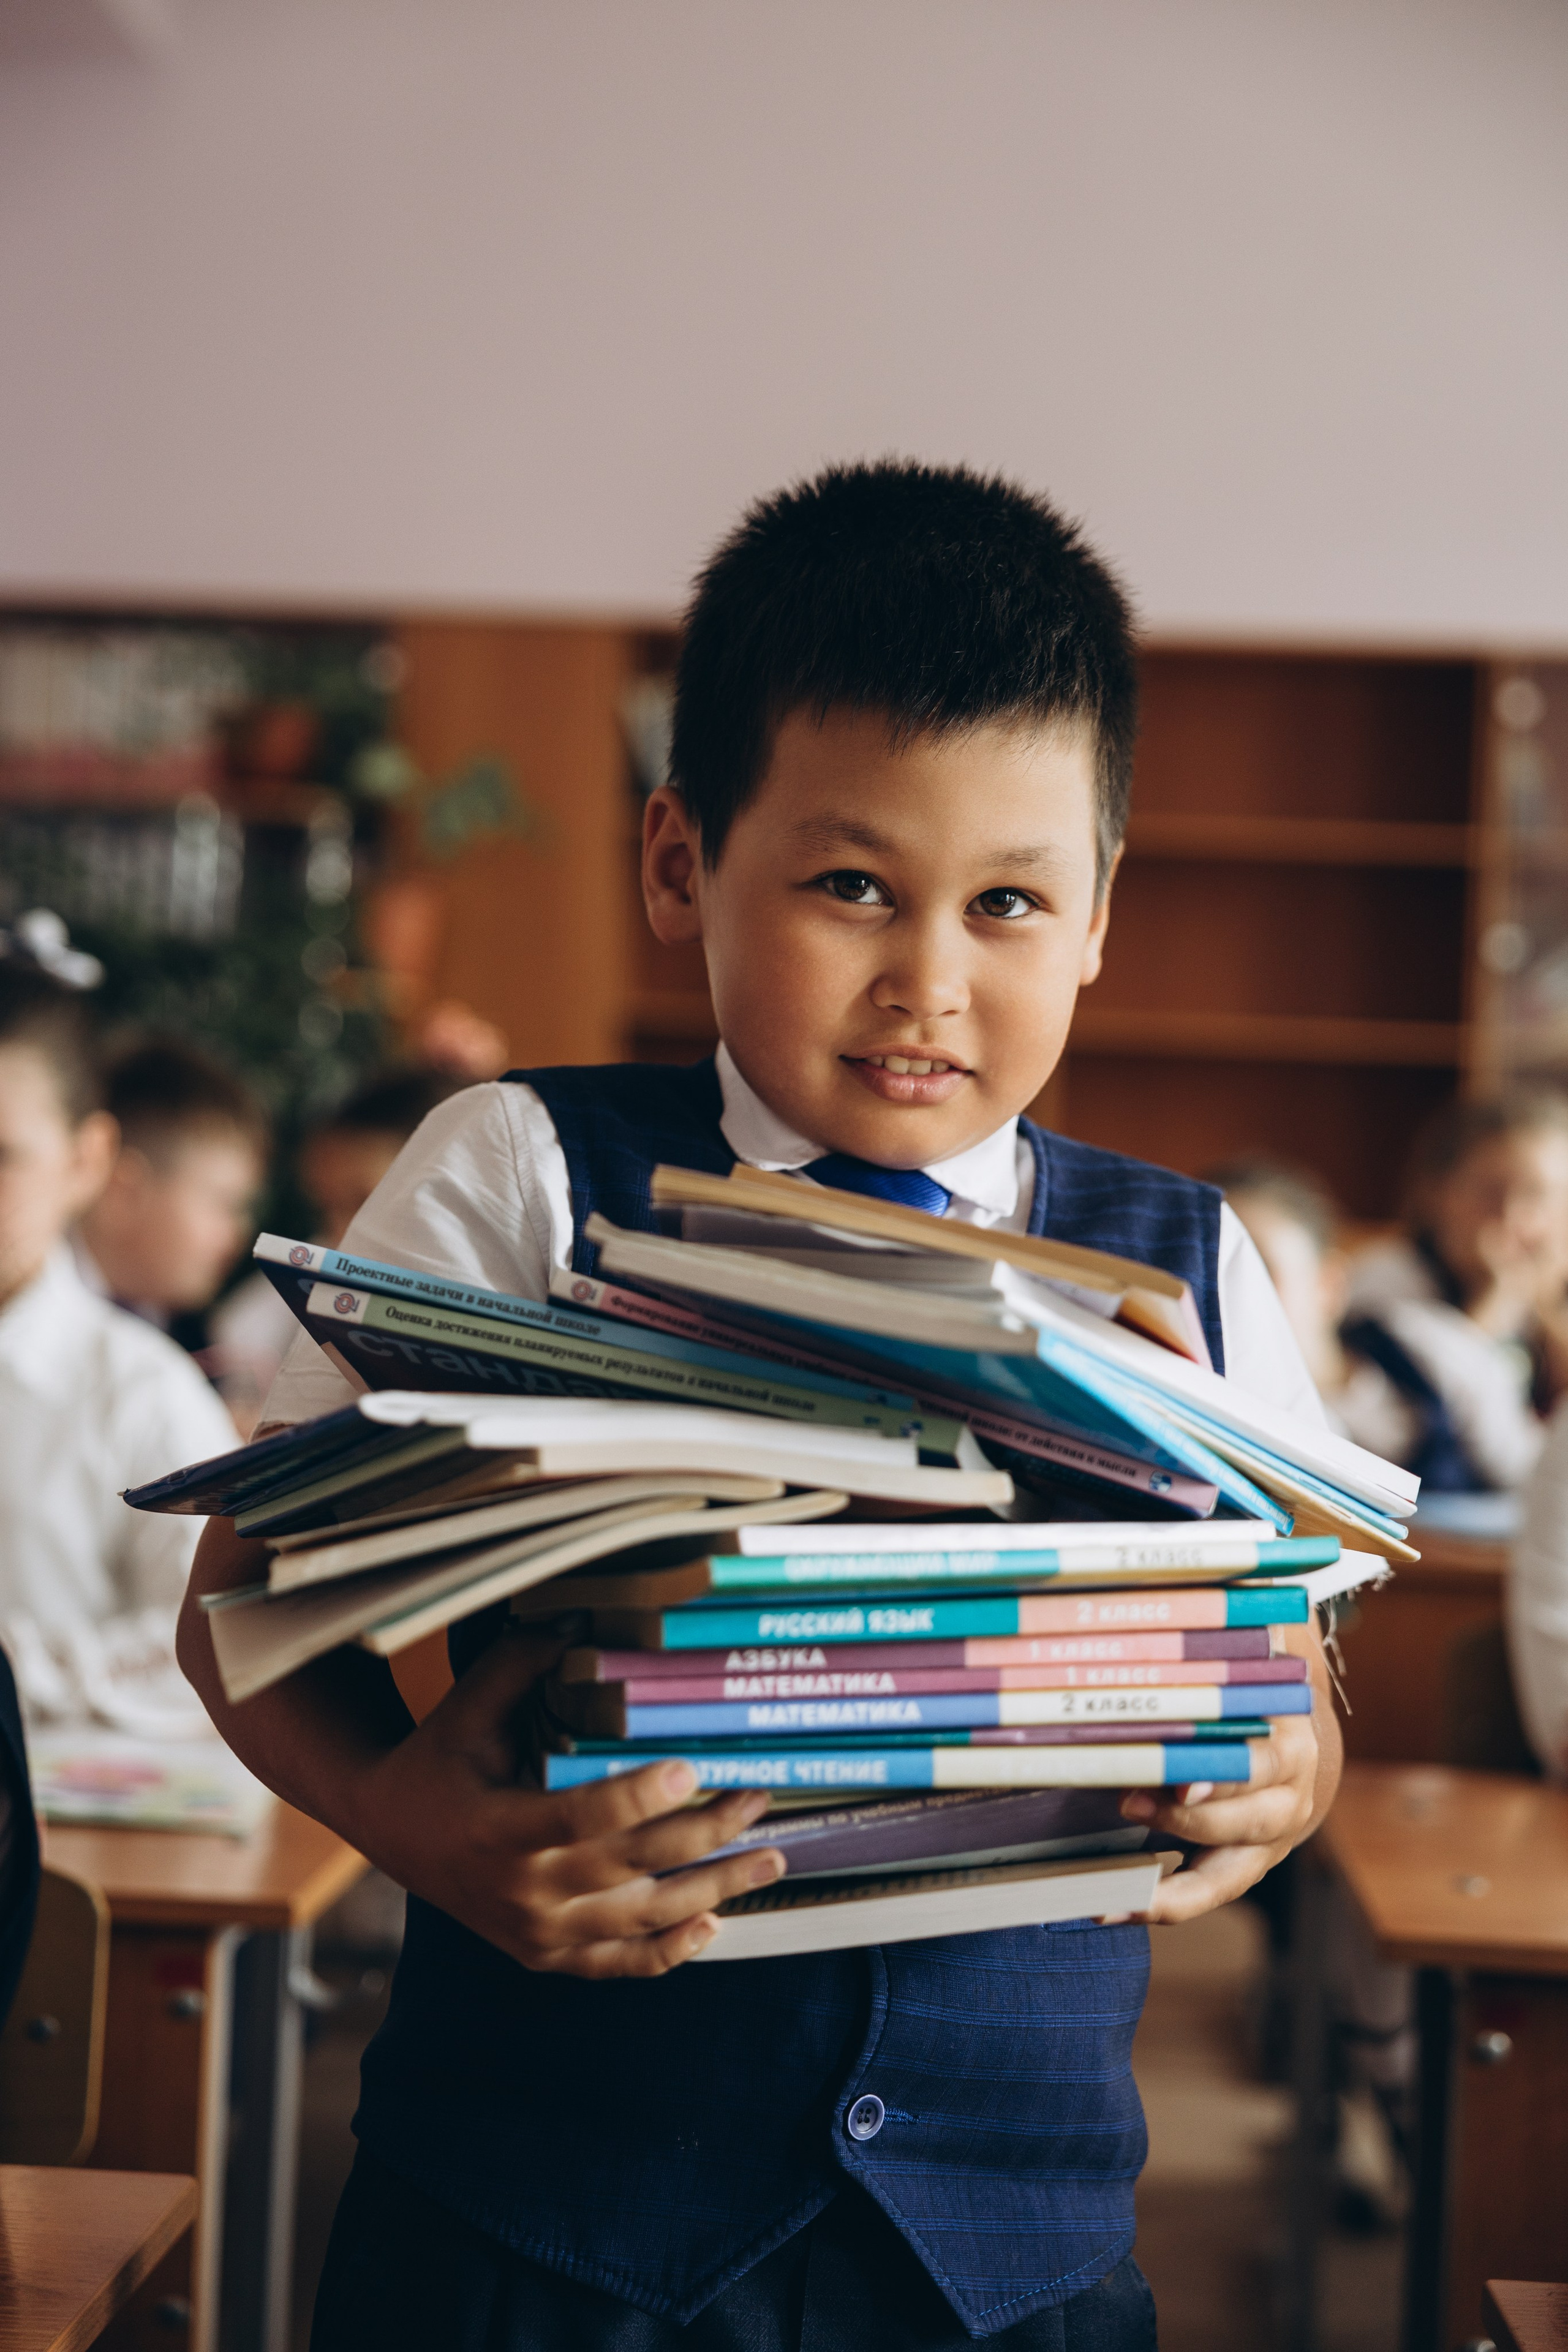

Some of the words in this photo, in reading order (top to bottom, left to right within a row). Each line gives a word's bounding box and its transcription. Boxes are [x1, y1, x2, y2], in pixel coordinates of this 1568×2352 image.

[336, 1257, 414, 1287] Проектные
[415, 1279, 464, 1302] задачи
[466, 1294, 475, 1304] в
[477, 1295, 553, 1324] начальной
[554, 1316, 602, 1335] школе
[385, 1305, 432, 1327] Оценка
[432, 1319, 512, 1345] достижения
[513, 1337, 604, 1365] планируемых
[605, 1357, 686, 1384] результатов
[611, 1295, 701, 1332] Формирование
[1014, 1430, 1029, 1442] от
[1029, 1435, 1085, 1461] действия
[1096, 1457, 1137, 1478] мысли
[1116, 1547, 1128, 1567] 2
[1137, 1549, 1204, 1566] класс
[758, 1608, 864, 1637] РУССКИЙ
[869, 1608, 934, 1633] ЯЗЫК
[1077, 1602, 1092, 1623] 2
[1099, 1602, 1170, 1621] класс
[725, 1647, 826, 1672] АЗБУКА
[1030, 1641, 1038, 1659] 1
[1050, 1641, 1123, 1658] класс
[723, 1673, 896, 1698] МАТЕМАТИКА
[1066, 1667, 1077, 1684] 1
[1087, 1665, 1161, 1683] класс
[747, 1700, 922, 1728] МАТЕМАТИКА
[1062, 1694, 1075, 1713] 2
[1085, 1695, 1159, 1712] класс
[796, 1758, 888, 1785] ЧТЕНИЕ
